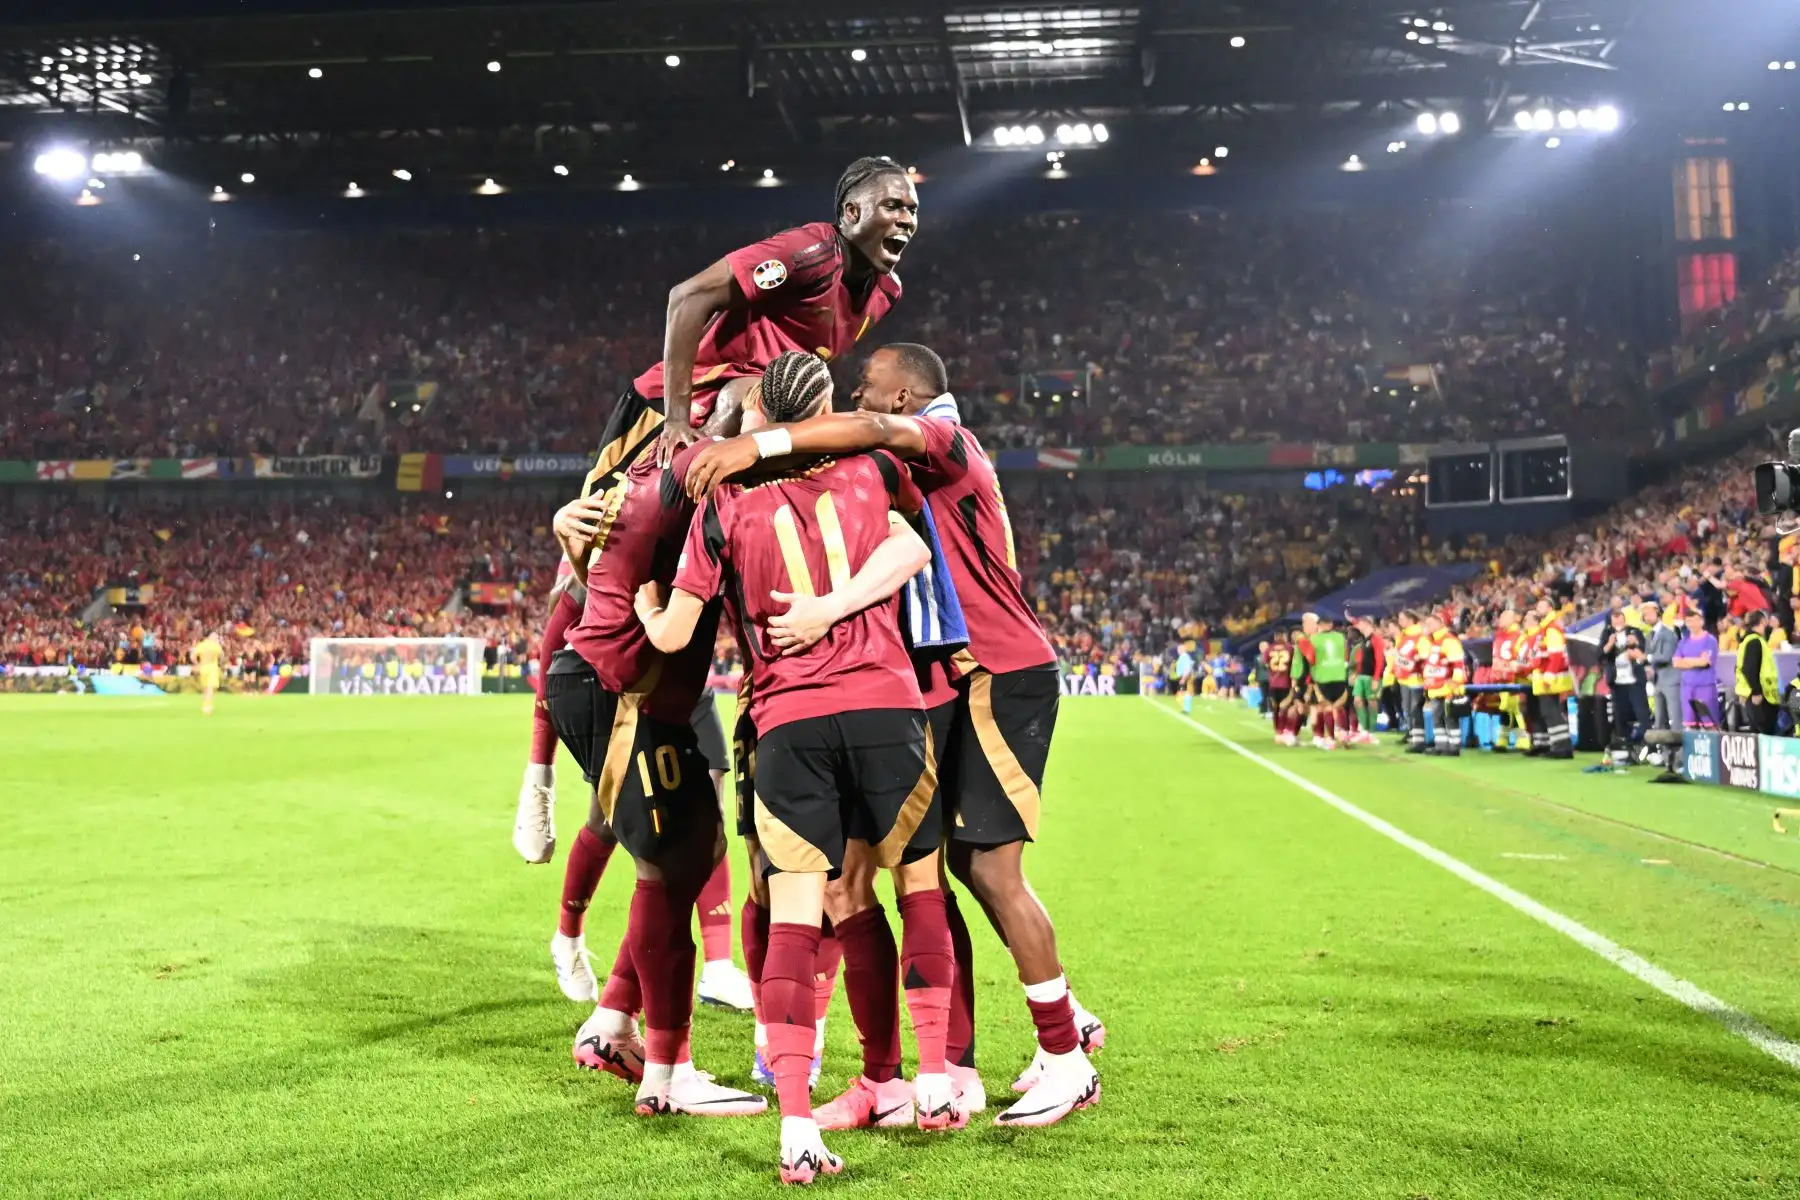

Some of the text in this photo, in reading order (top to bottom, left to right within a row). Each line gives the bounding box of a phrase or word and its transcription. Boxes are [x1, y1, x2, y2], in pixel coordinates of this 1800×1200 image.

[514, 458, 558, 471] EURO
[1148, 449, 1201, 466] KÖLN
[774, 490, 851, 597] 11
[1269, 649, 1290, 672] 22
[1059, 674, 1116, 696] ATAR
[1721, 735, 1756, 771] QATAR
[635, 744, 681, 797] 10
